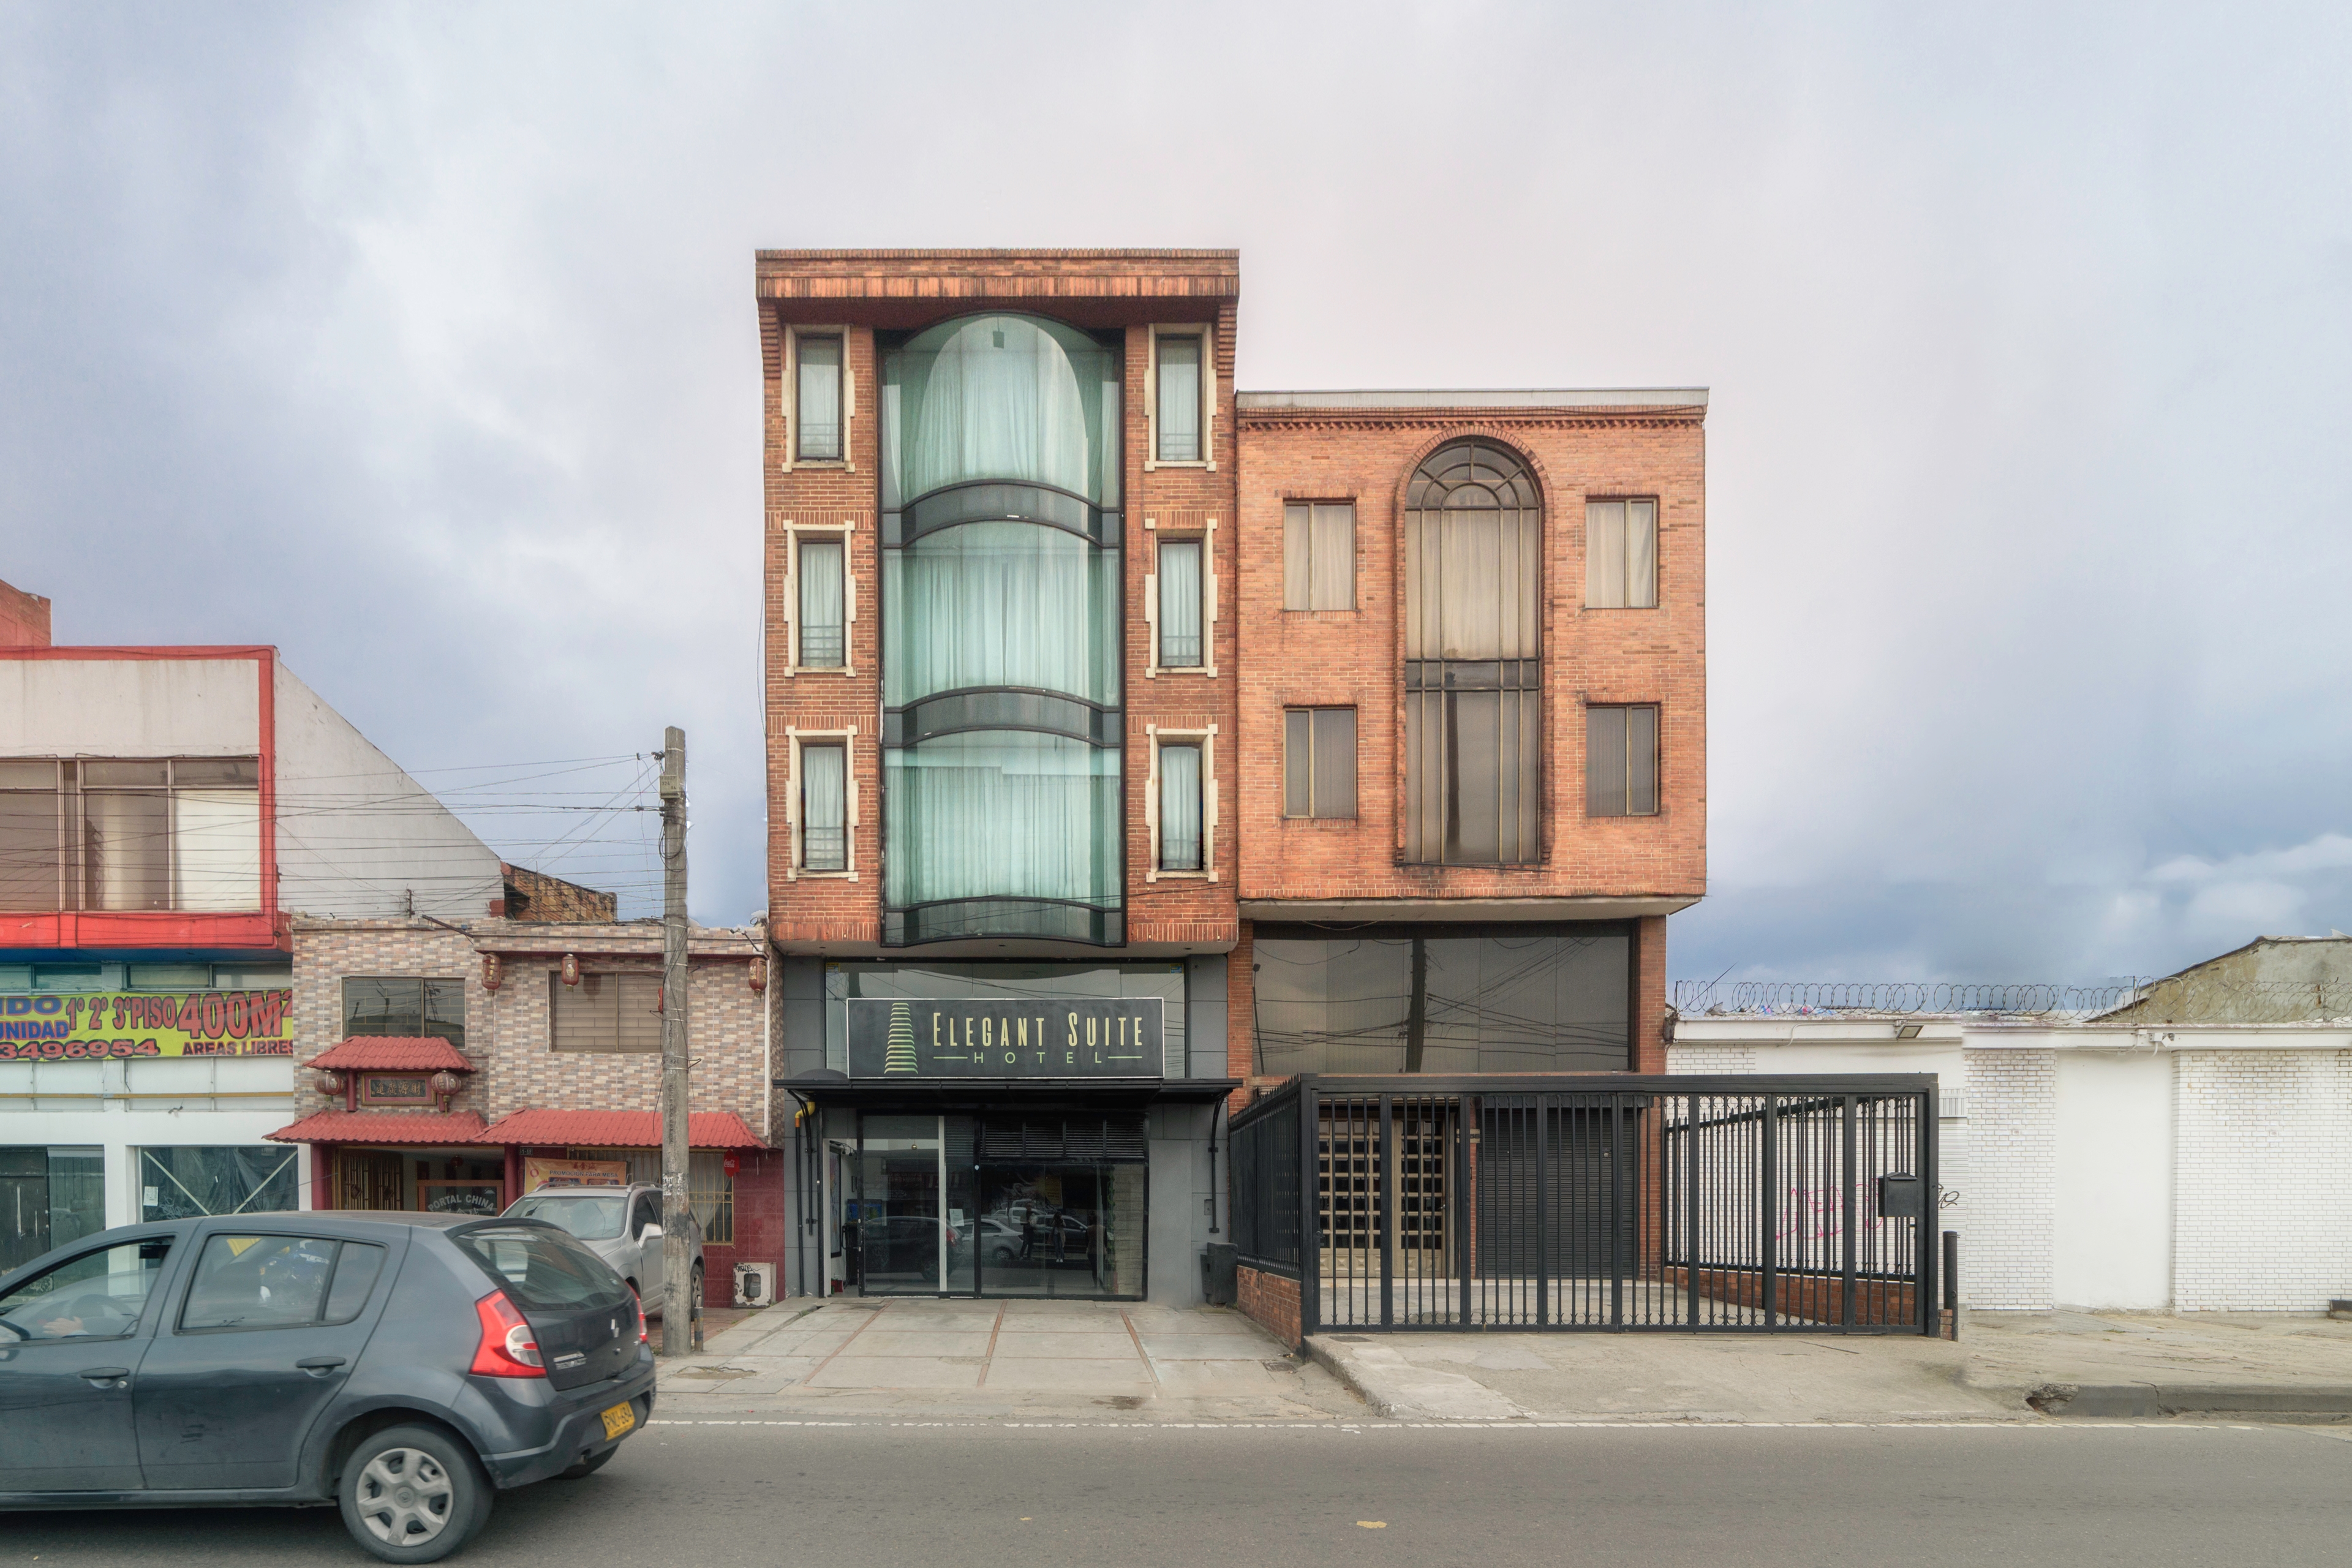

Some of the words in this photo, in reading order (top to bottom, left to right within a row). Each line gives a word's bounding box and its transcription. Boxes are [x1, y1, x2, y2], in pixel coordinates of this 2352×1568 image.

[0, 995, 63, 1016] DO
[933, 1012, 1044, 1046] ELEGANT
[1068, 1012, 1142, 1046] SUITE
[0, 1039, 160, 1061] 3496954
[182, 1041, 238, 1057] AREAS
[974, 1052, 1102, 1064] HOTEL
[428, 1194, 462, 1212] PORTAL
[466, 1194, 494, 1211] CHINA
